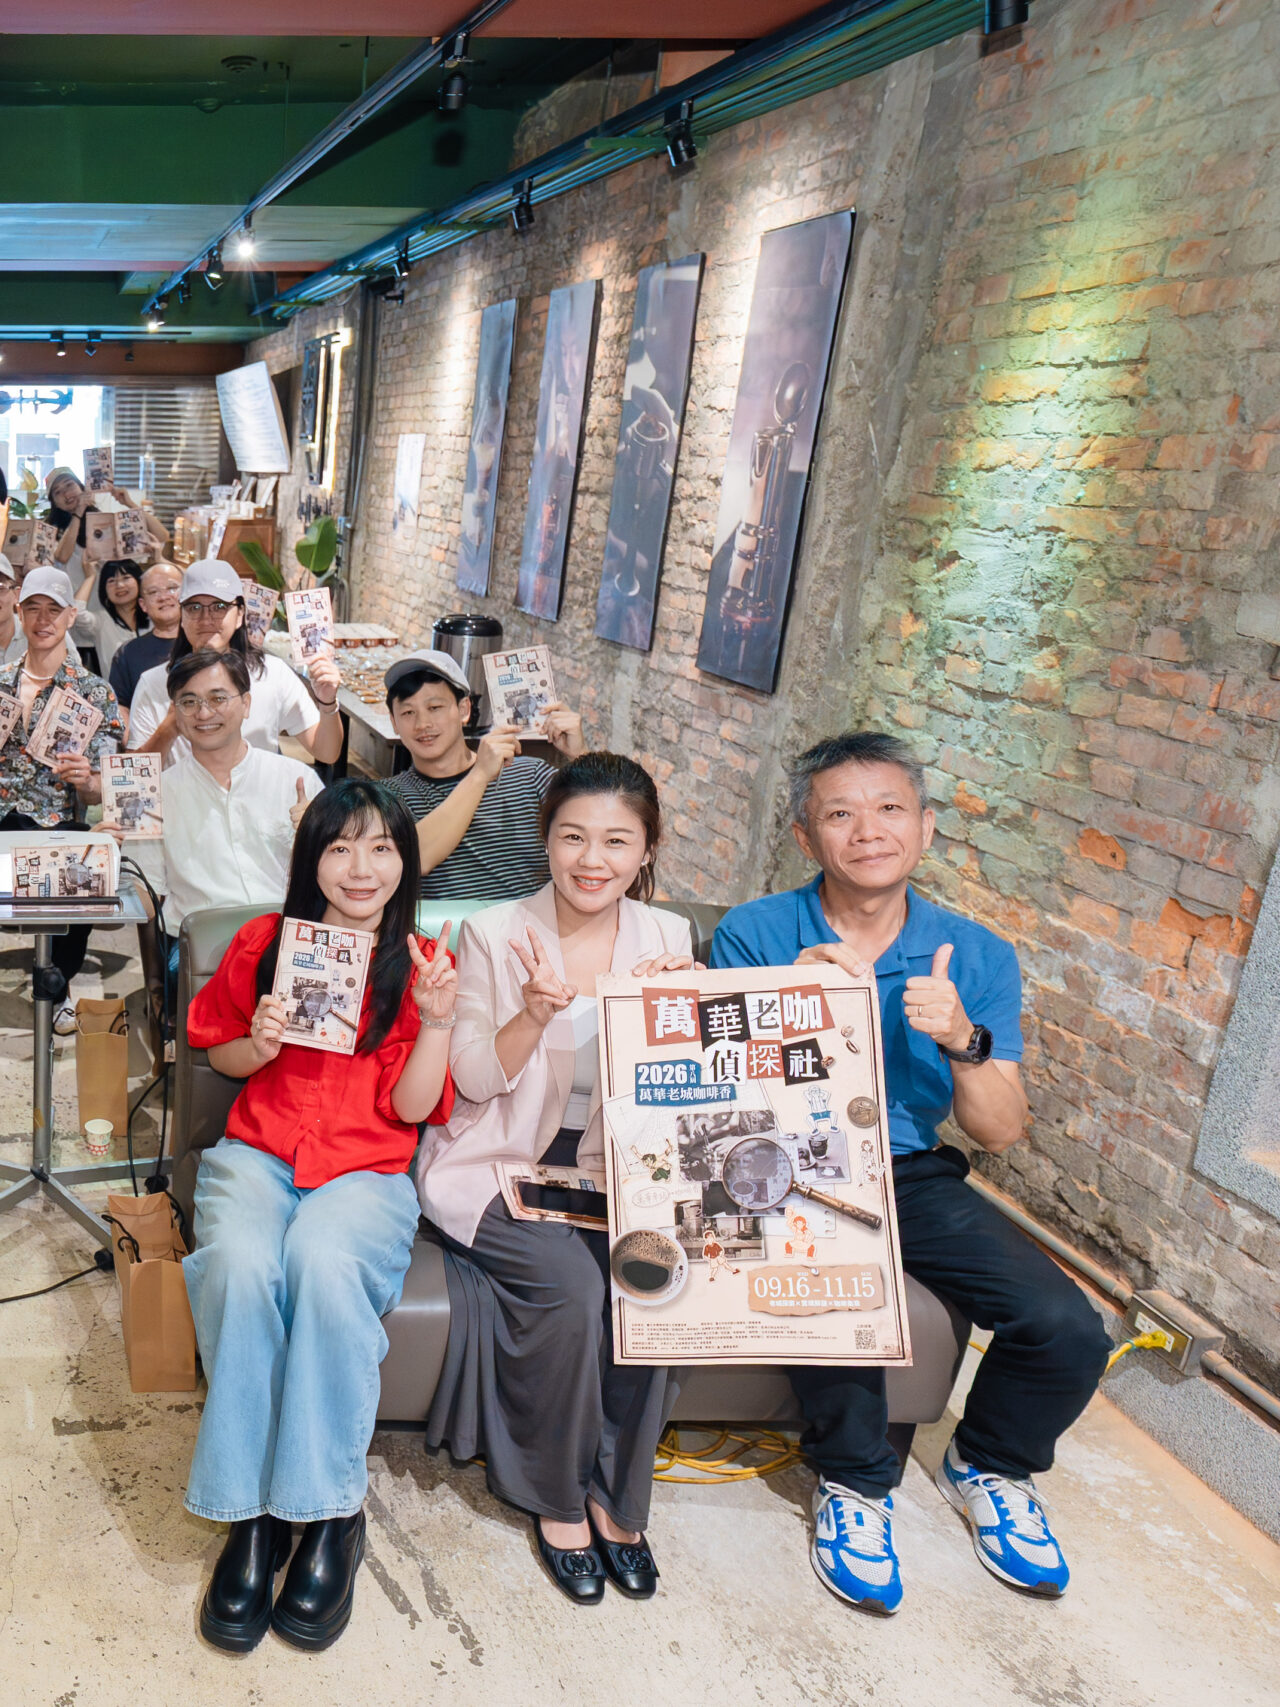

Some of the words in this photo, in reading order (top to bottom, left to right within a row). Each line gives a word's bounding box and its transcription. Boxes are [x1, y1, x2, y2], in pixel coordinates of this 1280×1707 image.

[651, 991, 824, 1041] 萬華老咖
[637, 1063, 688, 1085] 2026
[709, 1044, 819, 1084] 偵探社
[638, 1085, 732, 1102] 萬華老城咖啡香
